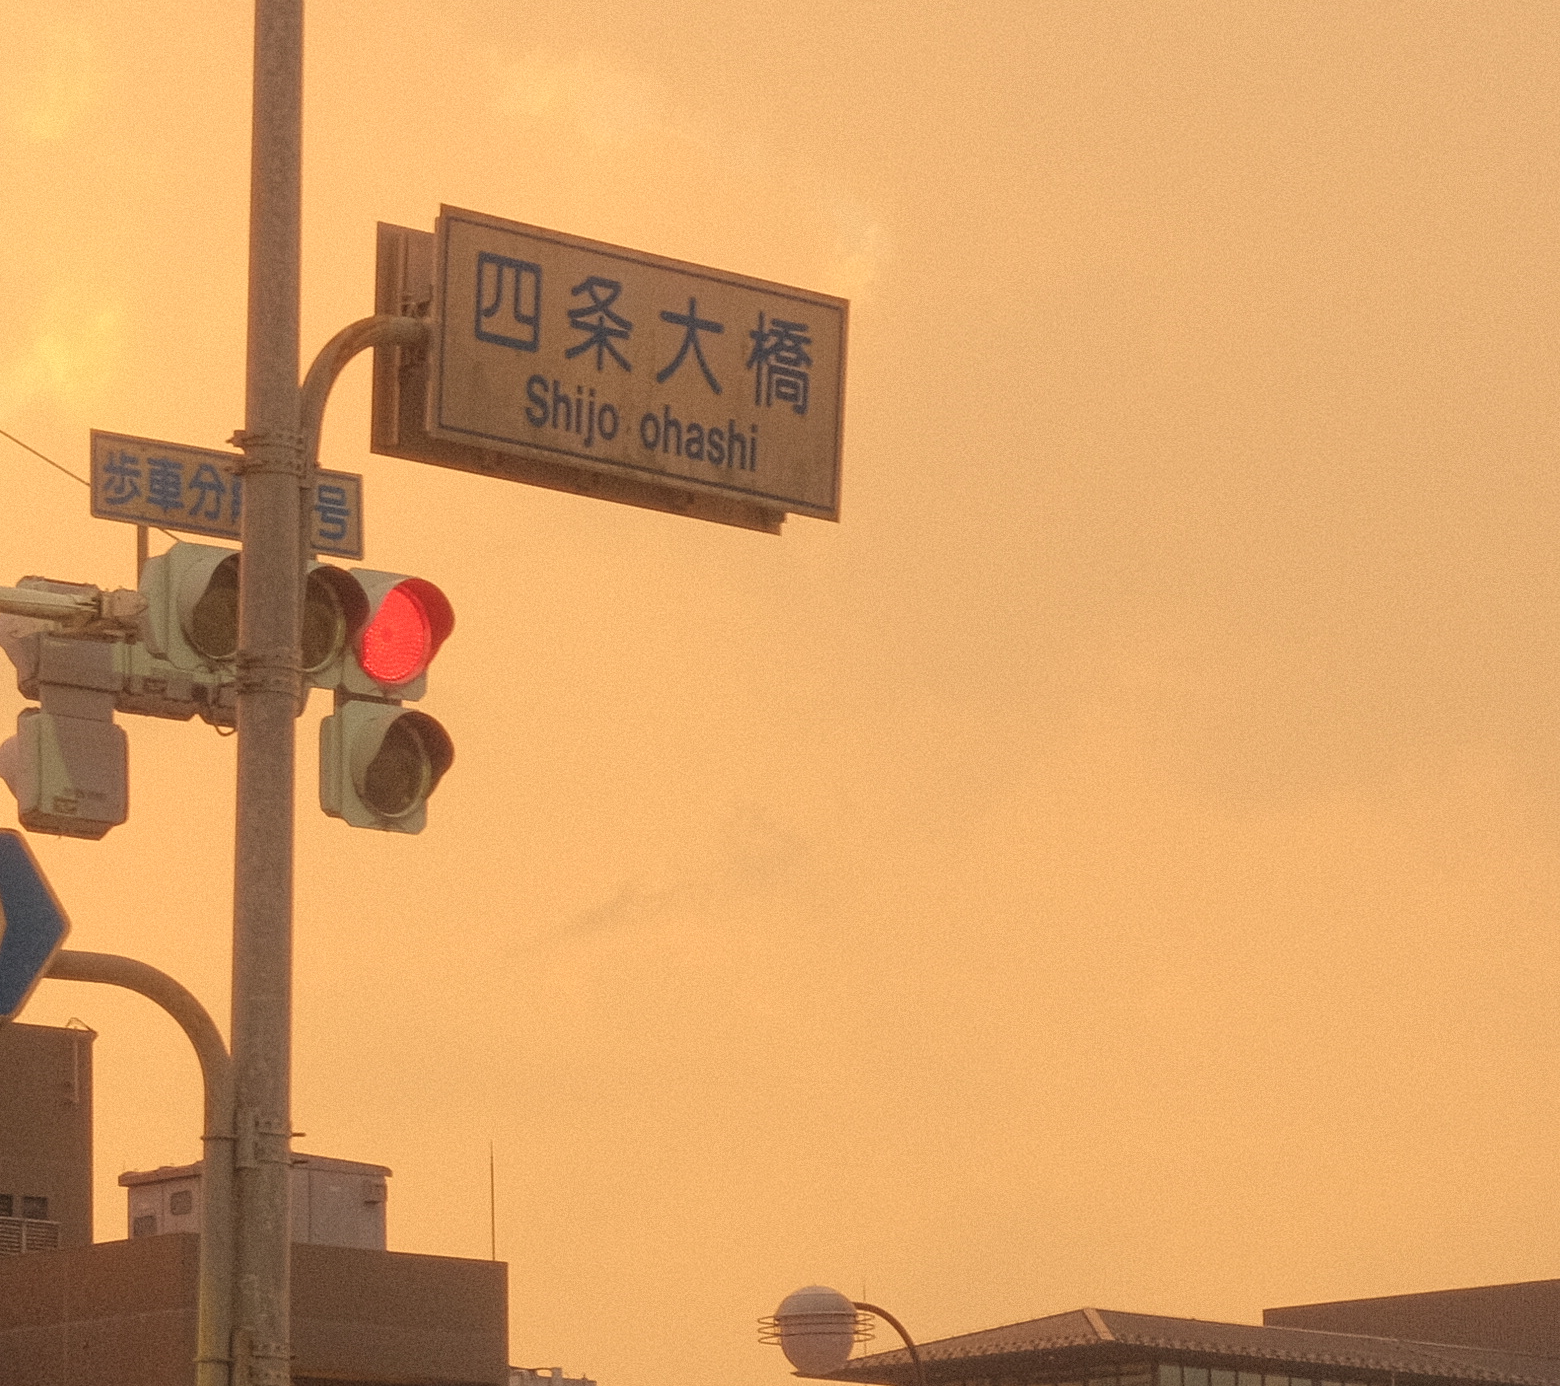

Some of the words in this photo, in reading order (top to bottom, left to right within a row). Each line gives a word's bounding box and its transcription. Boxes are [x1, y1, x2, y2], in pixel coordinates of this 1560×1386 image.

[475, 249, 814, 416] 四条大橋
[525, 373, 619, 448] Shijo
[639, 407, 759, 472] ohashi
